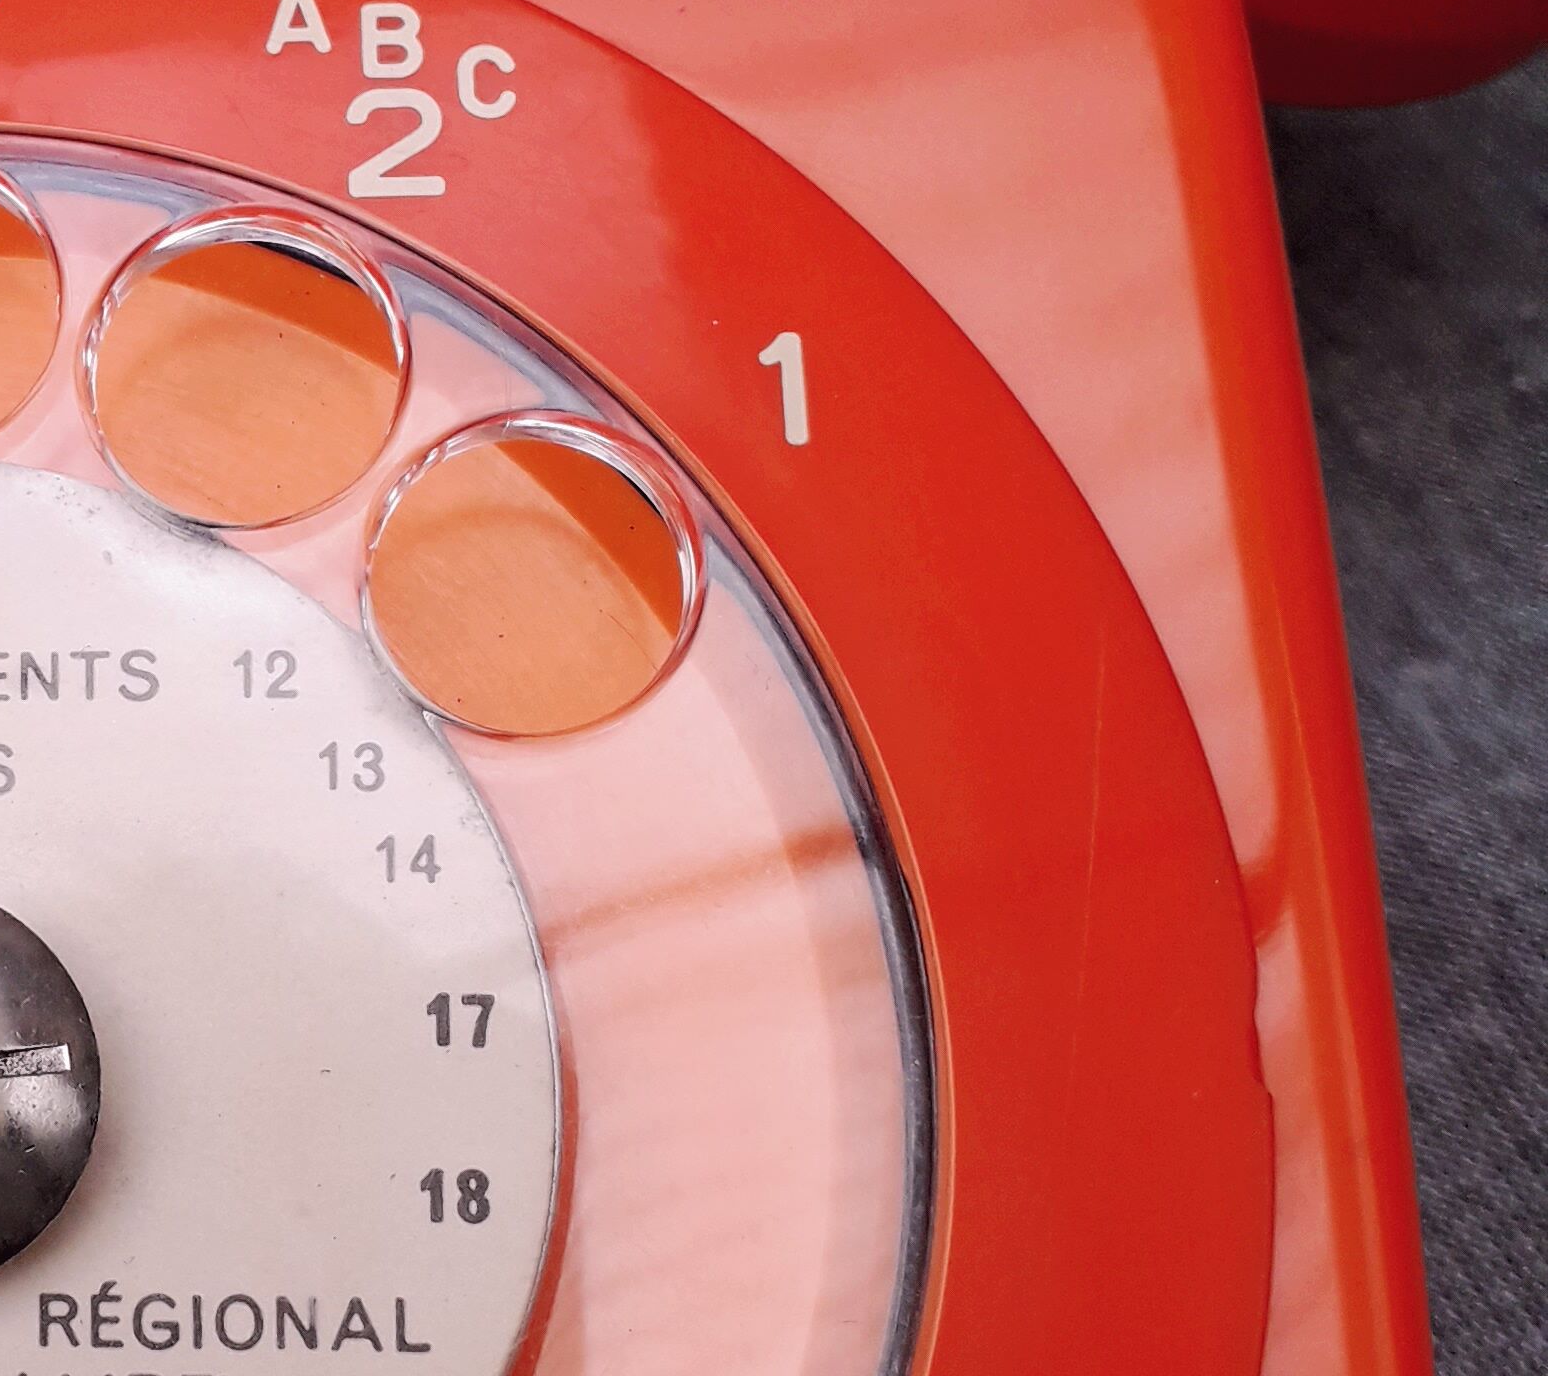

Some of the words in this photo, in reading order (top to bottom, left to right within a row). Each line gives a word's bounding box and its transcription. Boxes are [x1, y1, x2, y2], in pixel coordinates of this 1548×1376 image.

[345, 87, 447, 198] 2
[757, 331, 809, 446] 1
[233, 650, 299, 701] 12
[319, 743, 387, 792] 13
[376, 835, 443, 883] 14
[426, 993, 498, 1047] 17
[420, 1169, 490, 1224] 18
[39, 1279, 431, 1355] RÉGIONAL
